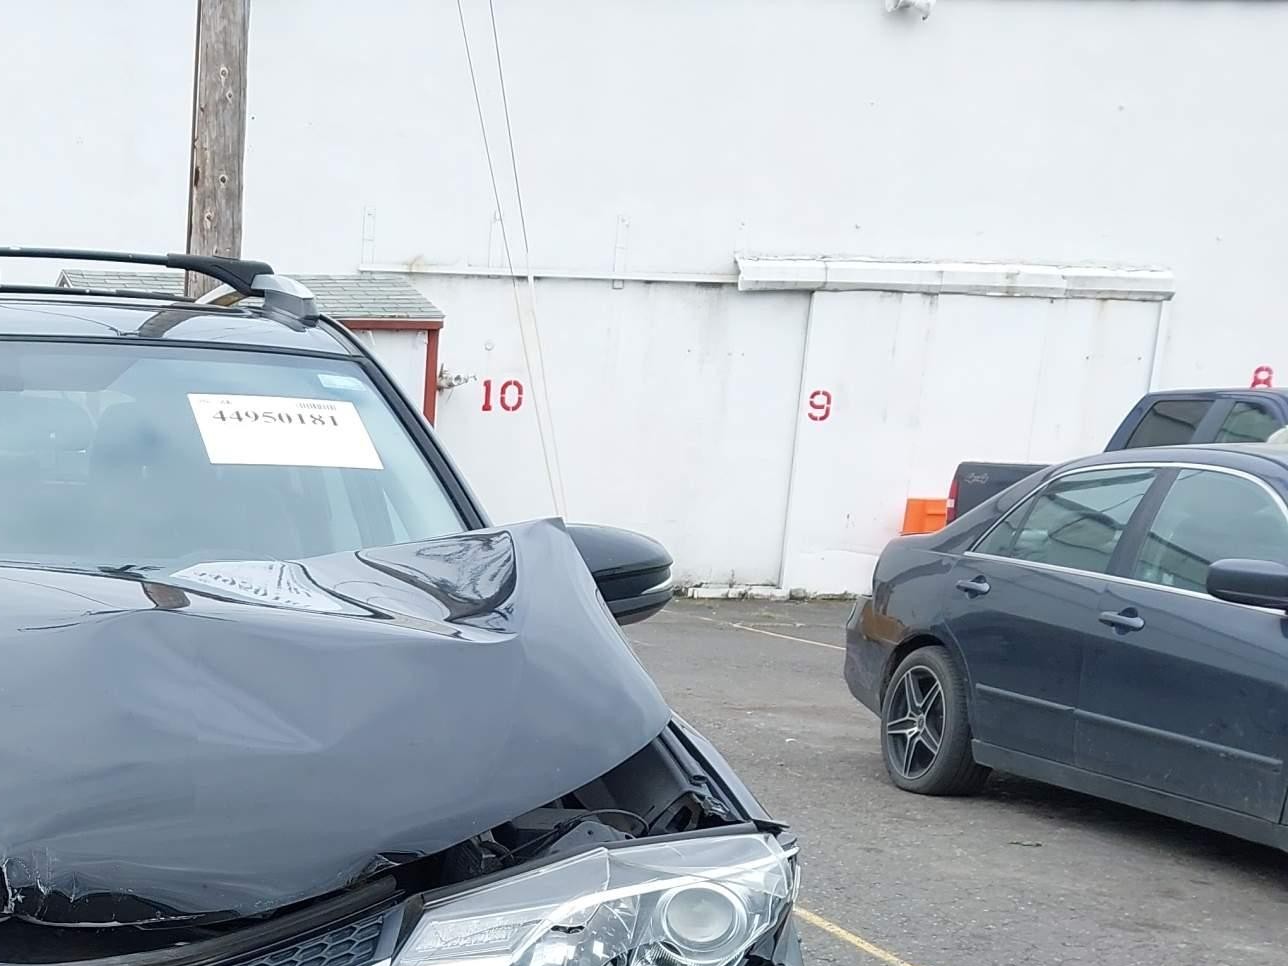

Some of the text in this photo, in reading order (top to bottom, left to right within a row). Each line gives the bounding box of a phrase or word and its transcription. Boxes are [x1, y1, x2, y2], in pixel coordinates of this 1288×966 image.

[1251, 366, 1274, 389] 8
[481, 379, 524, 412] 10
[807, 390, 832, 422] 9
[212, 409, 340, 427] 44950181
